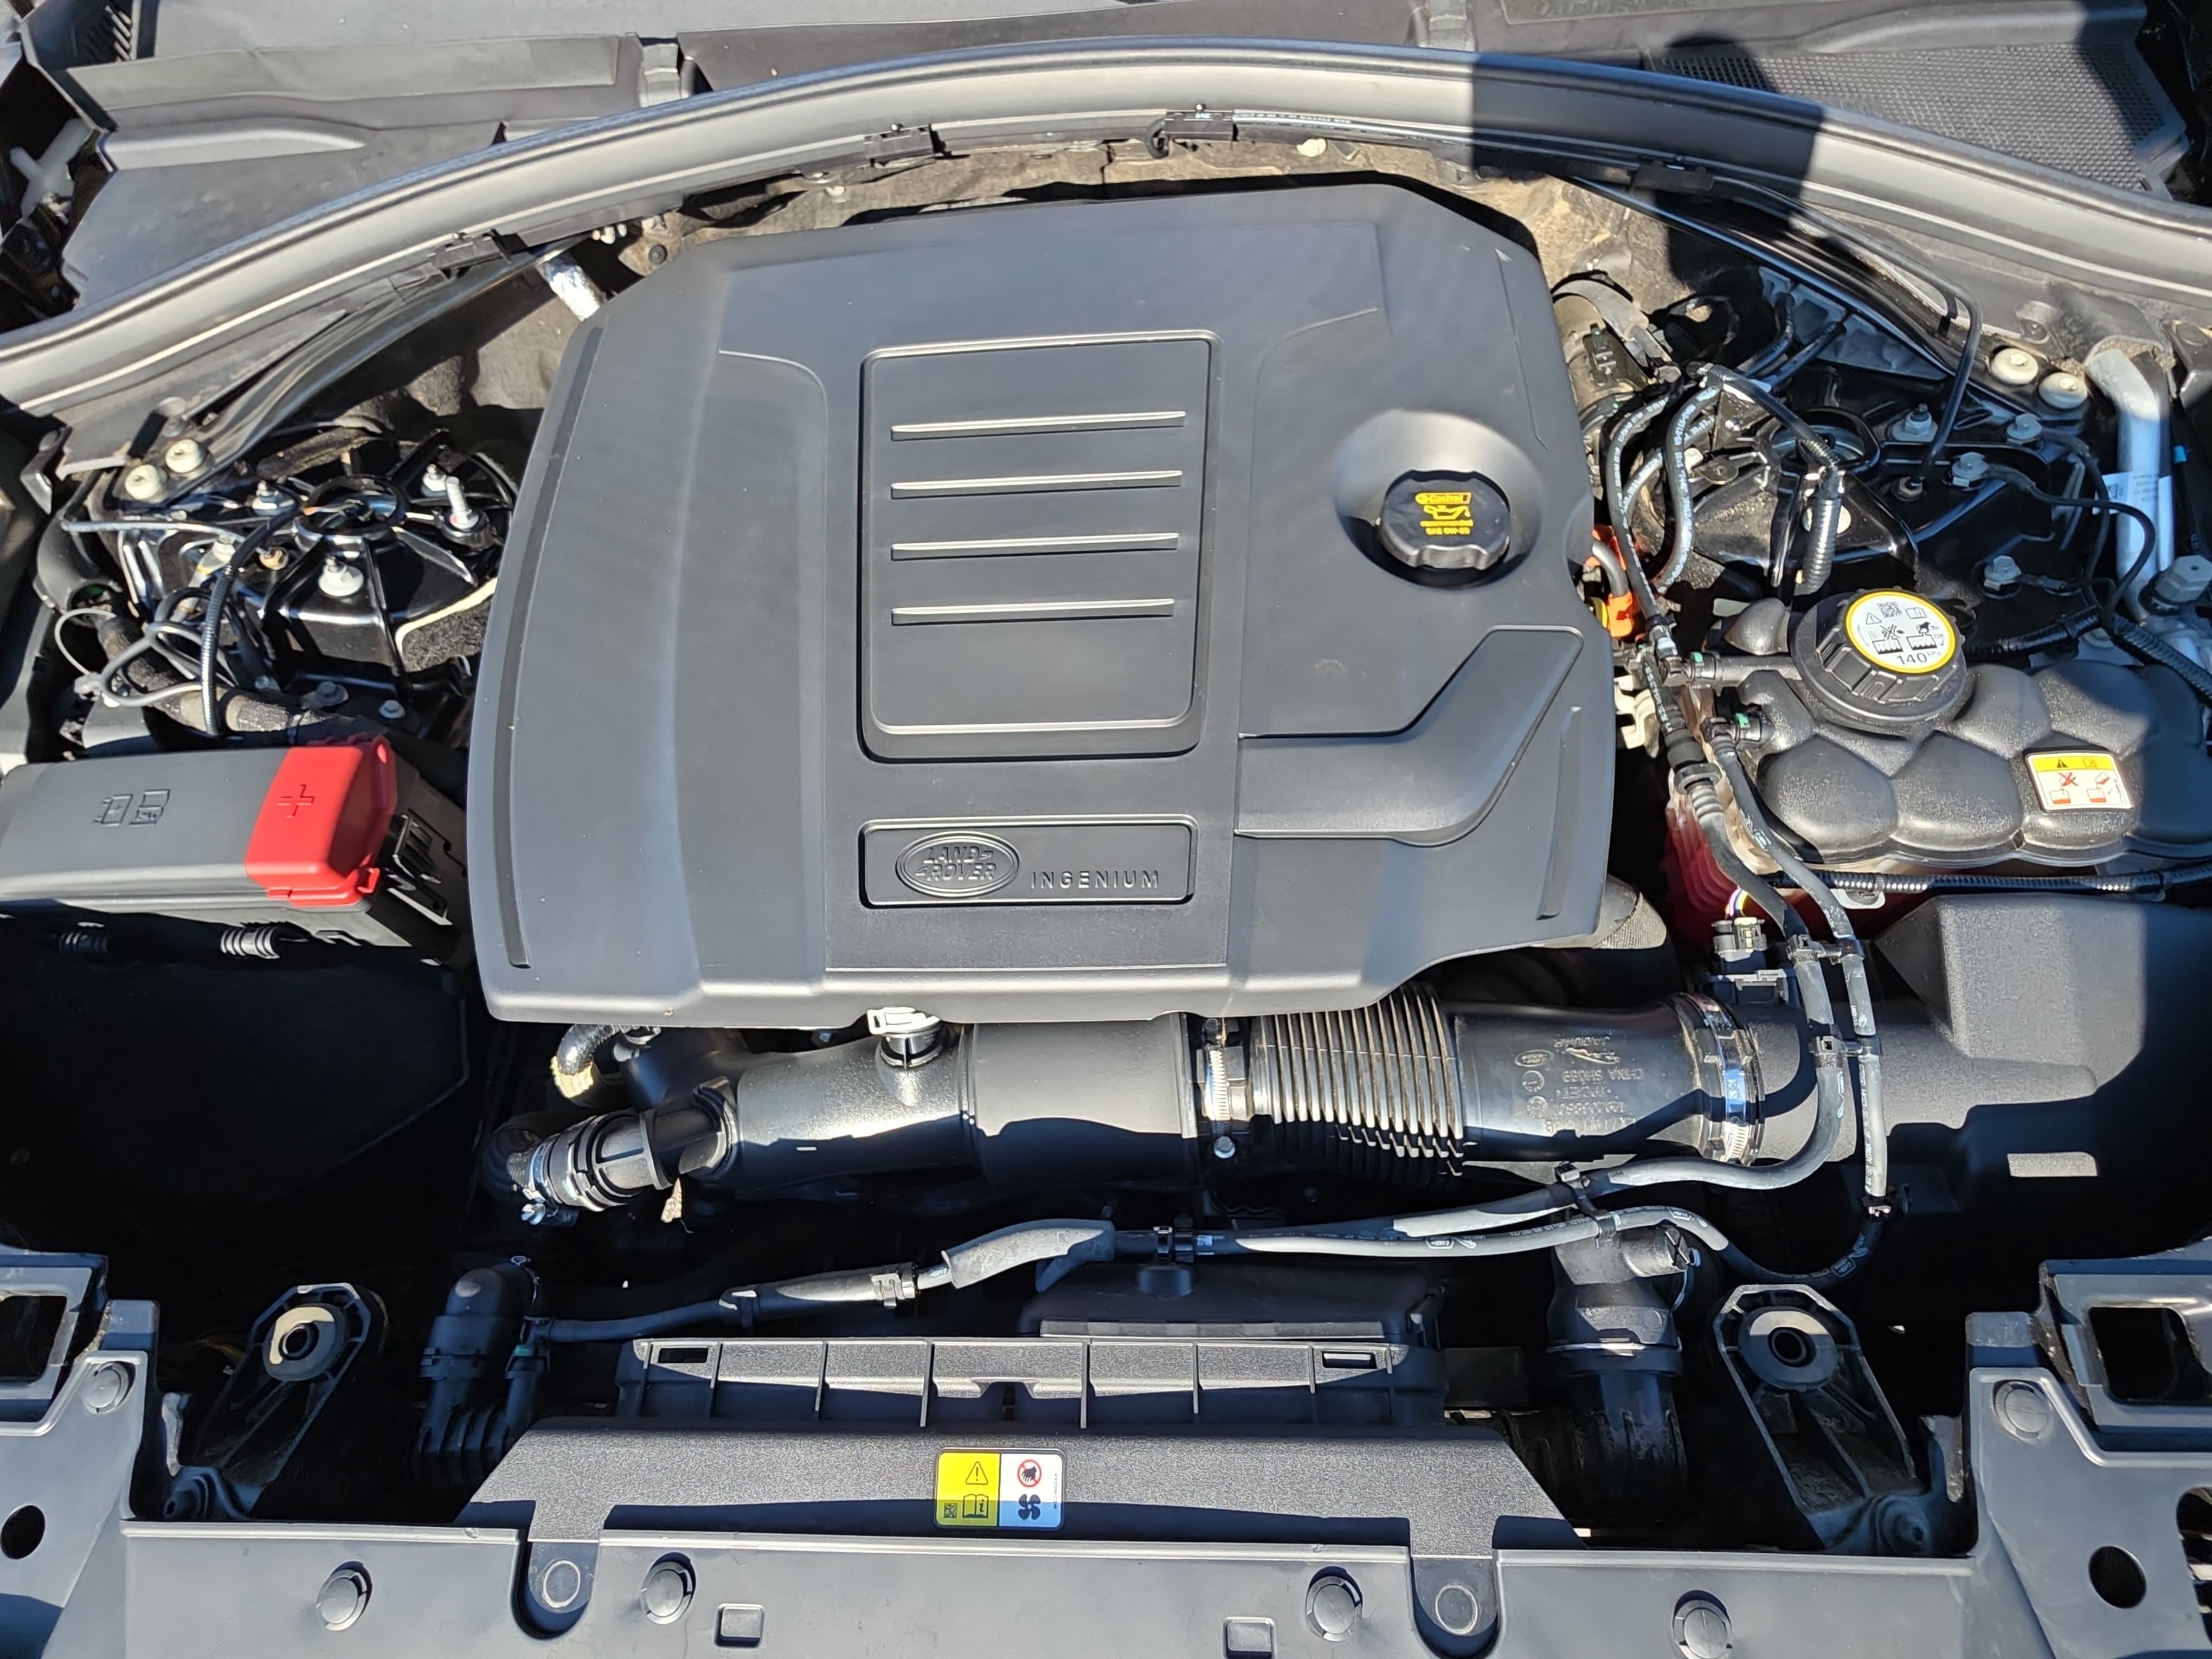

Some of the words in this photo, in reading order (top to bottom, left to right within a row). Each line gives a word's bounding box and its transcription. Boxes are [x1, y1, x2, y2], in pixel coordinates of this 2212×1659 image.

[1896, 652, 1927, 665] 140
[923, 846, 981, 864] LAND
[926, 863, 998, 882] ROVER
[1031, 870, 1159, 889] INGENIUM
